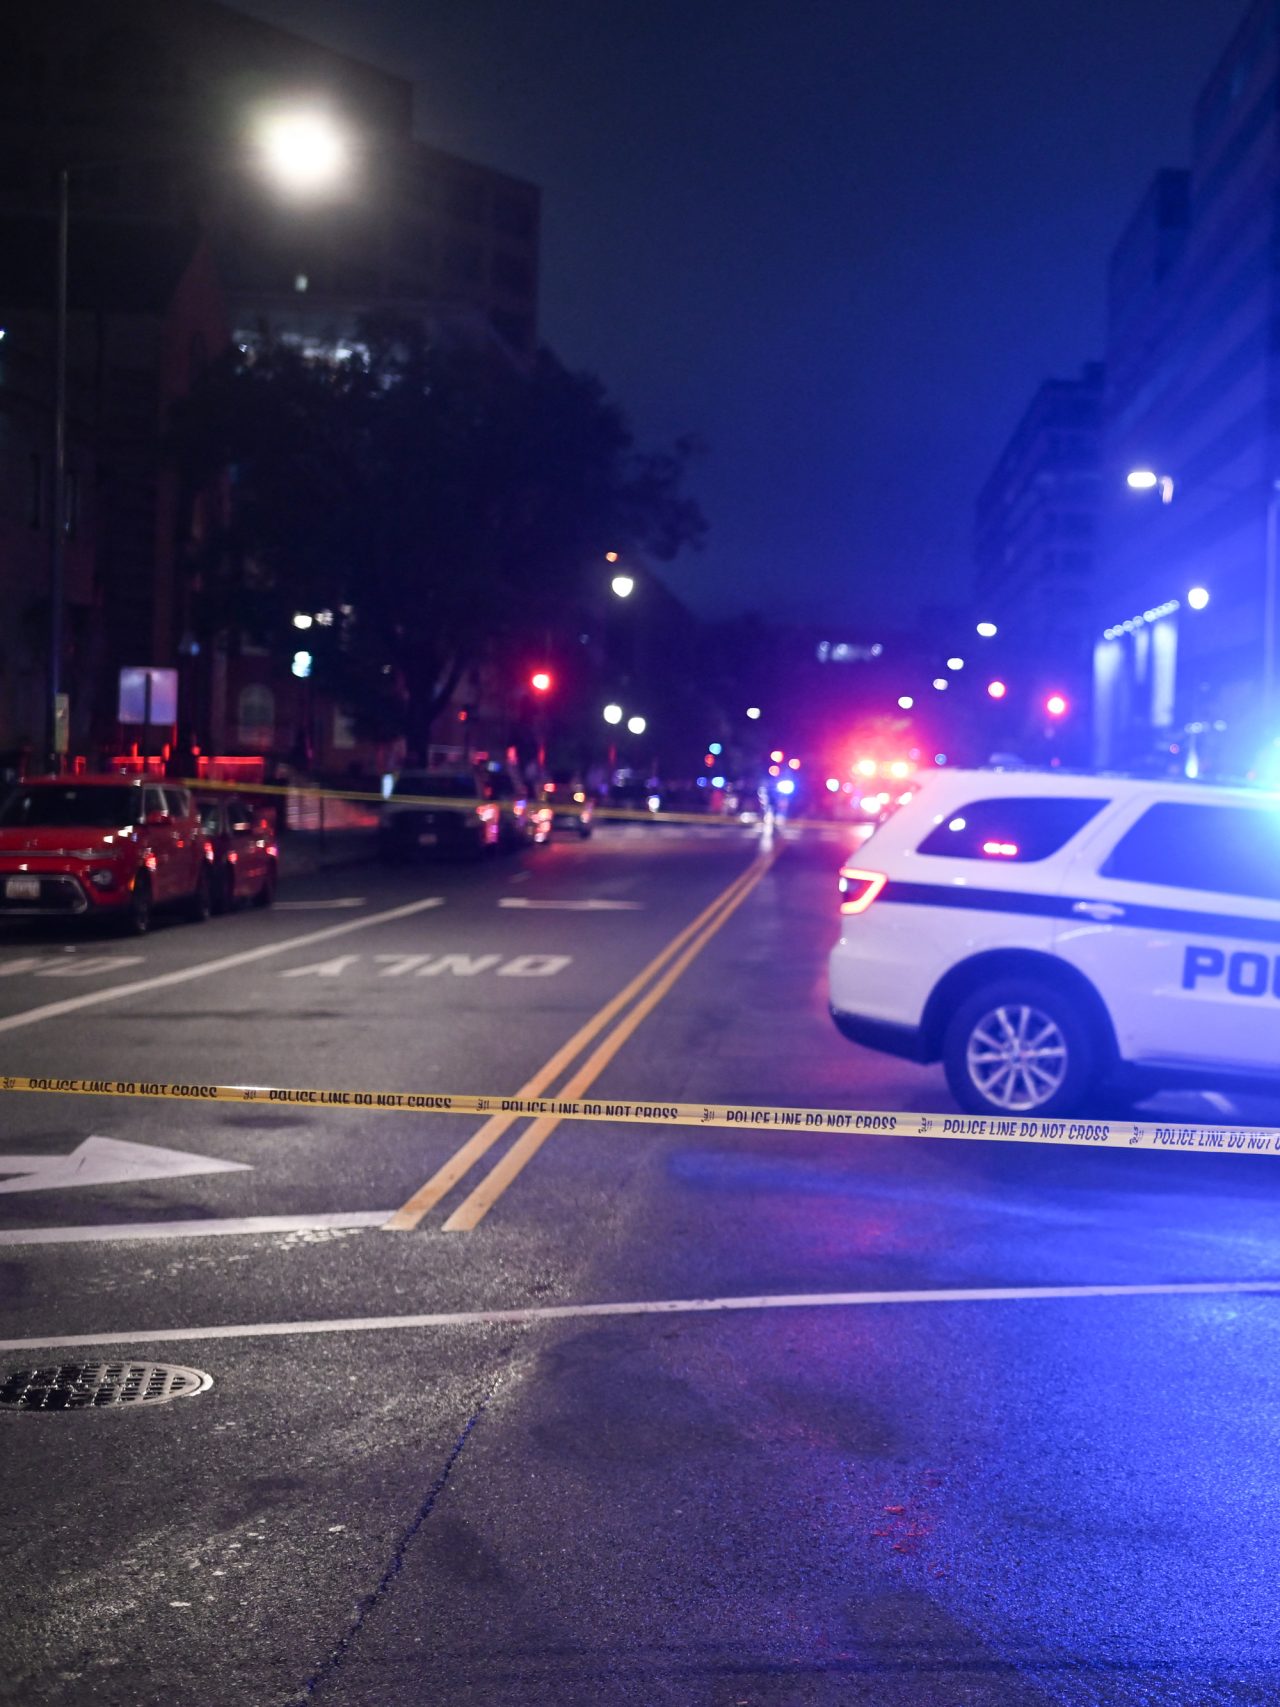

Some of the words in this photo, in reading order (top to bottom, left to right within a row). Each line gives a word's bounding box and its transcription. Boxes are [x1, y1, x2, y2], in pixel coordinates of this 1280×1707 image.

[278, 953, 574, 978] ONLY
[29, 1079, 78, 1091] POLICE
[82, 1081, 111, 1093] LINE
[117, 1083, 137, 1095] DO
[140, 1084, 167, 1096] NOT
[172, 1085, 217, 1098] CROSS
[269, 1090, 316, 1102] POLICE
[320, 1092, 350, 1104] LINE
[354, 1094, 372, 1105] DO
[377, 1095, 403, 1107] NOT
[408, 1096, 452, 1108] CROSS
[501, 1100, 547, 1113] POLICE
[551, 1102, 579, 1114] LINE
[584, 1104, 602, 1115] DO
[605, 1105, 631, 1117] NOT
[635, 1107, 678, 1119] CROSS
[726, 1110, 770, 1124] POLICE
[774, 1112, 802, 1125] LINE
[805, 1114, 822, 1127] DO
[827, 1114, 852, 1127] NOT
[855, 1116, 897, 1130] CROSS
[943, 1119, 987, 1135] POLICE
[989, 1122, 1017, 1136] LINE
[1019, 1123, 1037, 1137] DO
[1040, 1124, 1066, 1139] NOT
[1068, 1125, 1109, 1141] CROSS
[1153, 1128, 1196, 1146] POLICE
[1198, 1130, 1223, 1147] LINE
[1227, 1132, 1245, 1148] DO
[1247, 1133, 1271, 1149] NOT
